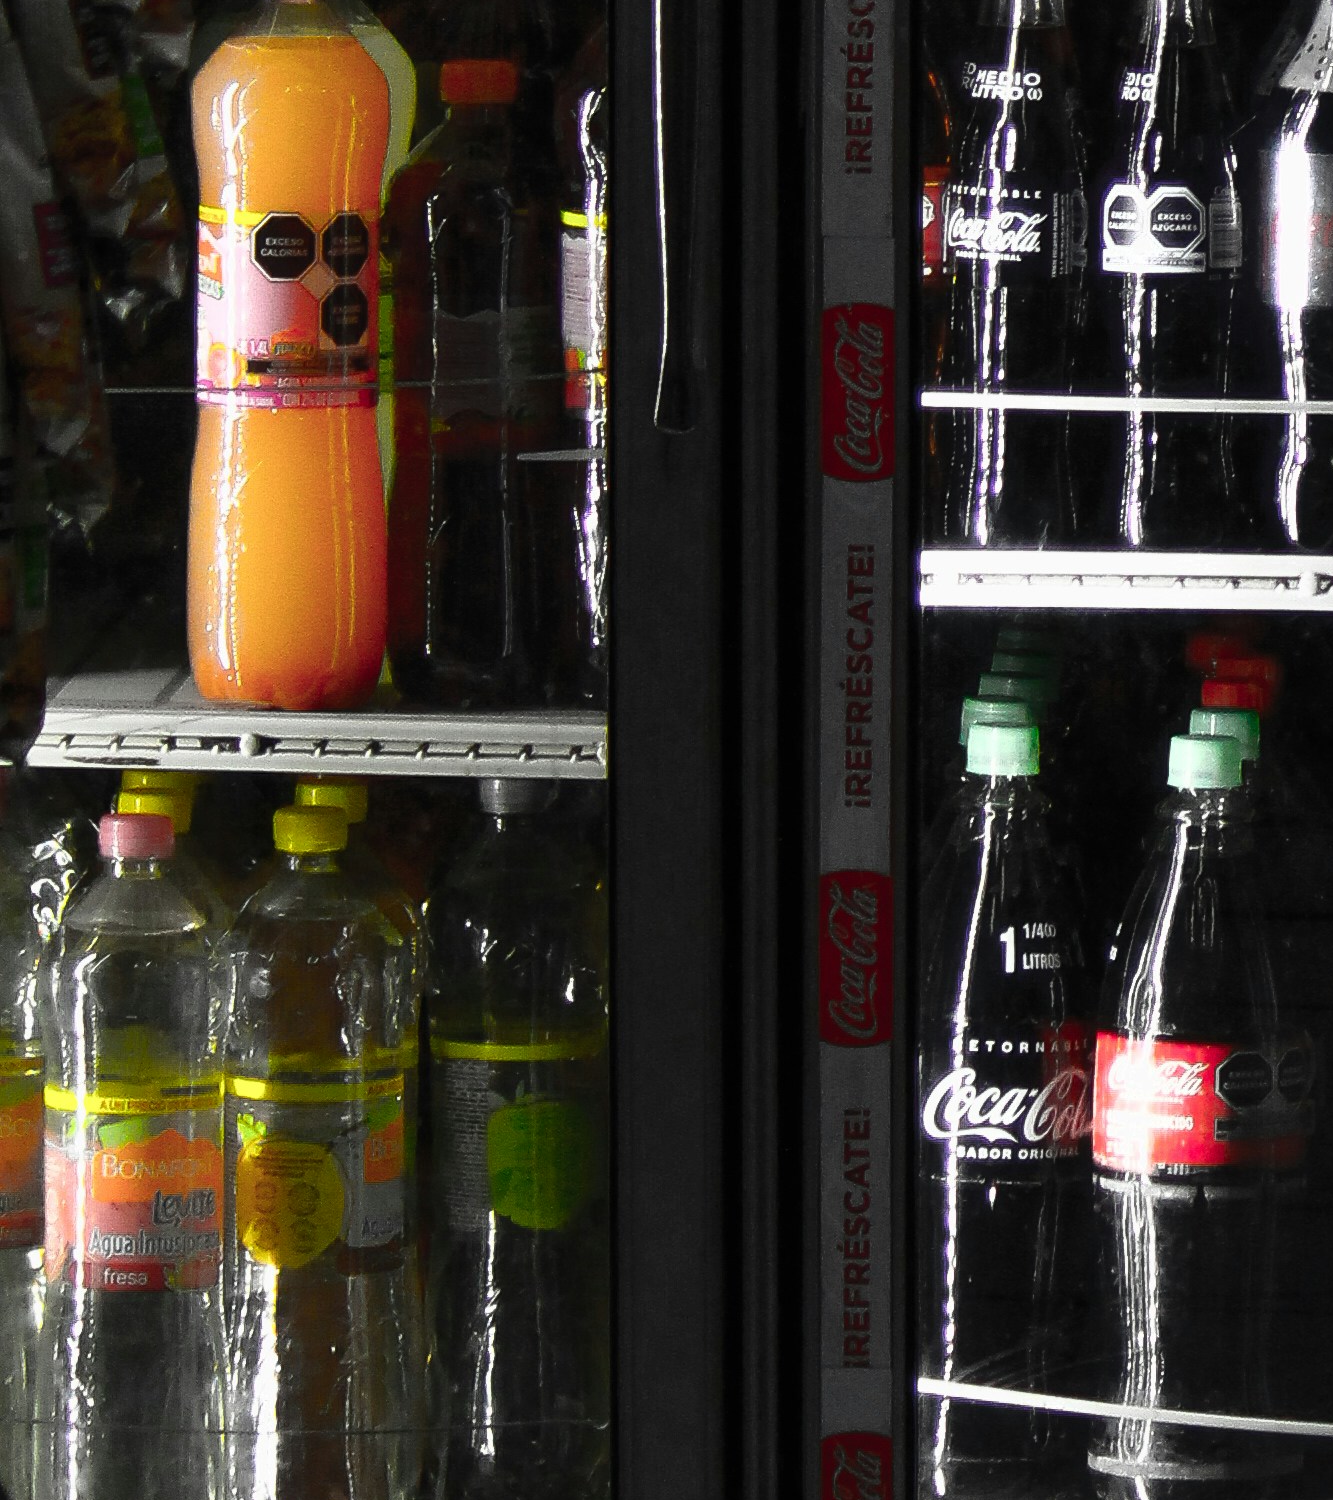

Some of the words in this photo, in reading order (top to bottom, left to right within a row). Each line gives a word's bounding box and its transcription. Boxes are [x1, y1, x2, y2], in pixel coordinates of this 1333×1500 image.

[1156, 212, 1194, 222] EXCESO
[264, 237, 305, 248] EXCESO
[1021, 952, 1062, 971] LITROS
[955, 1146, 1013, 1161] SABOR
[102, 1269, 149, 1286] fresa
